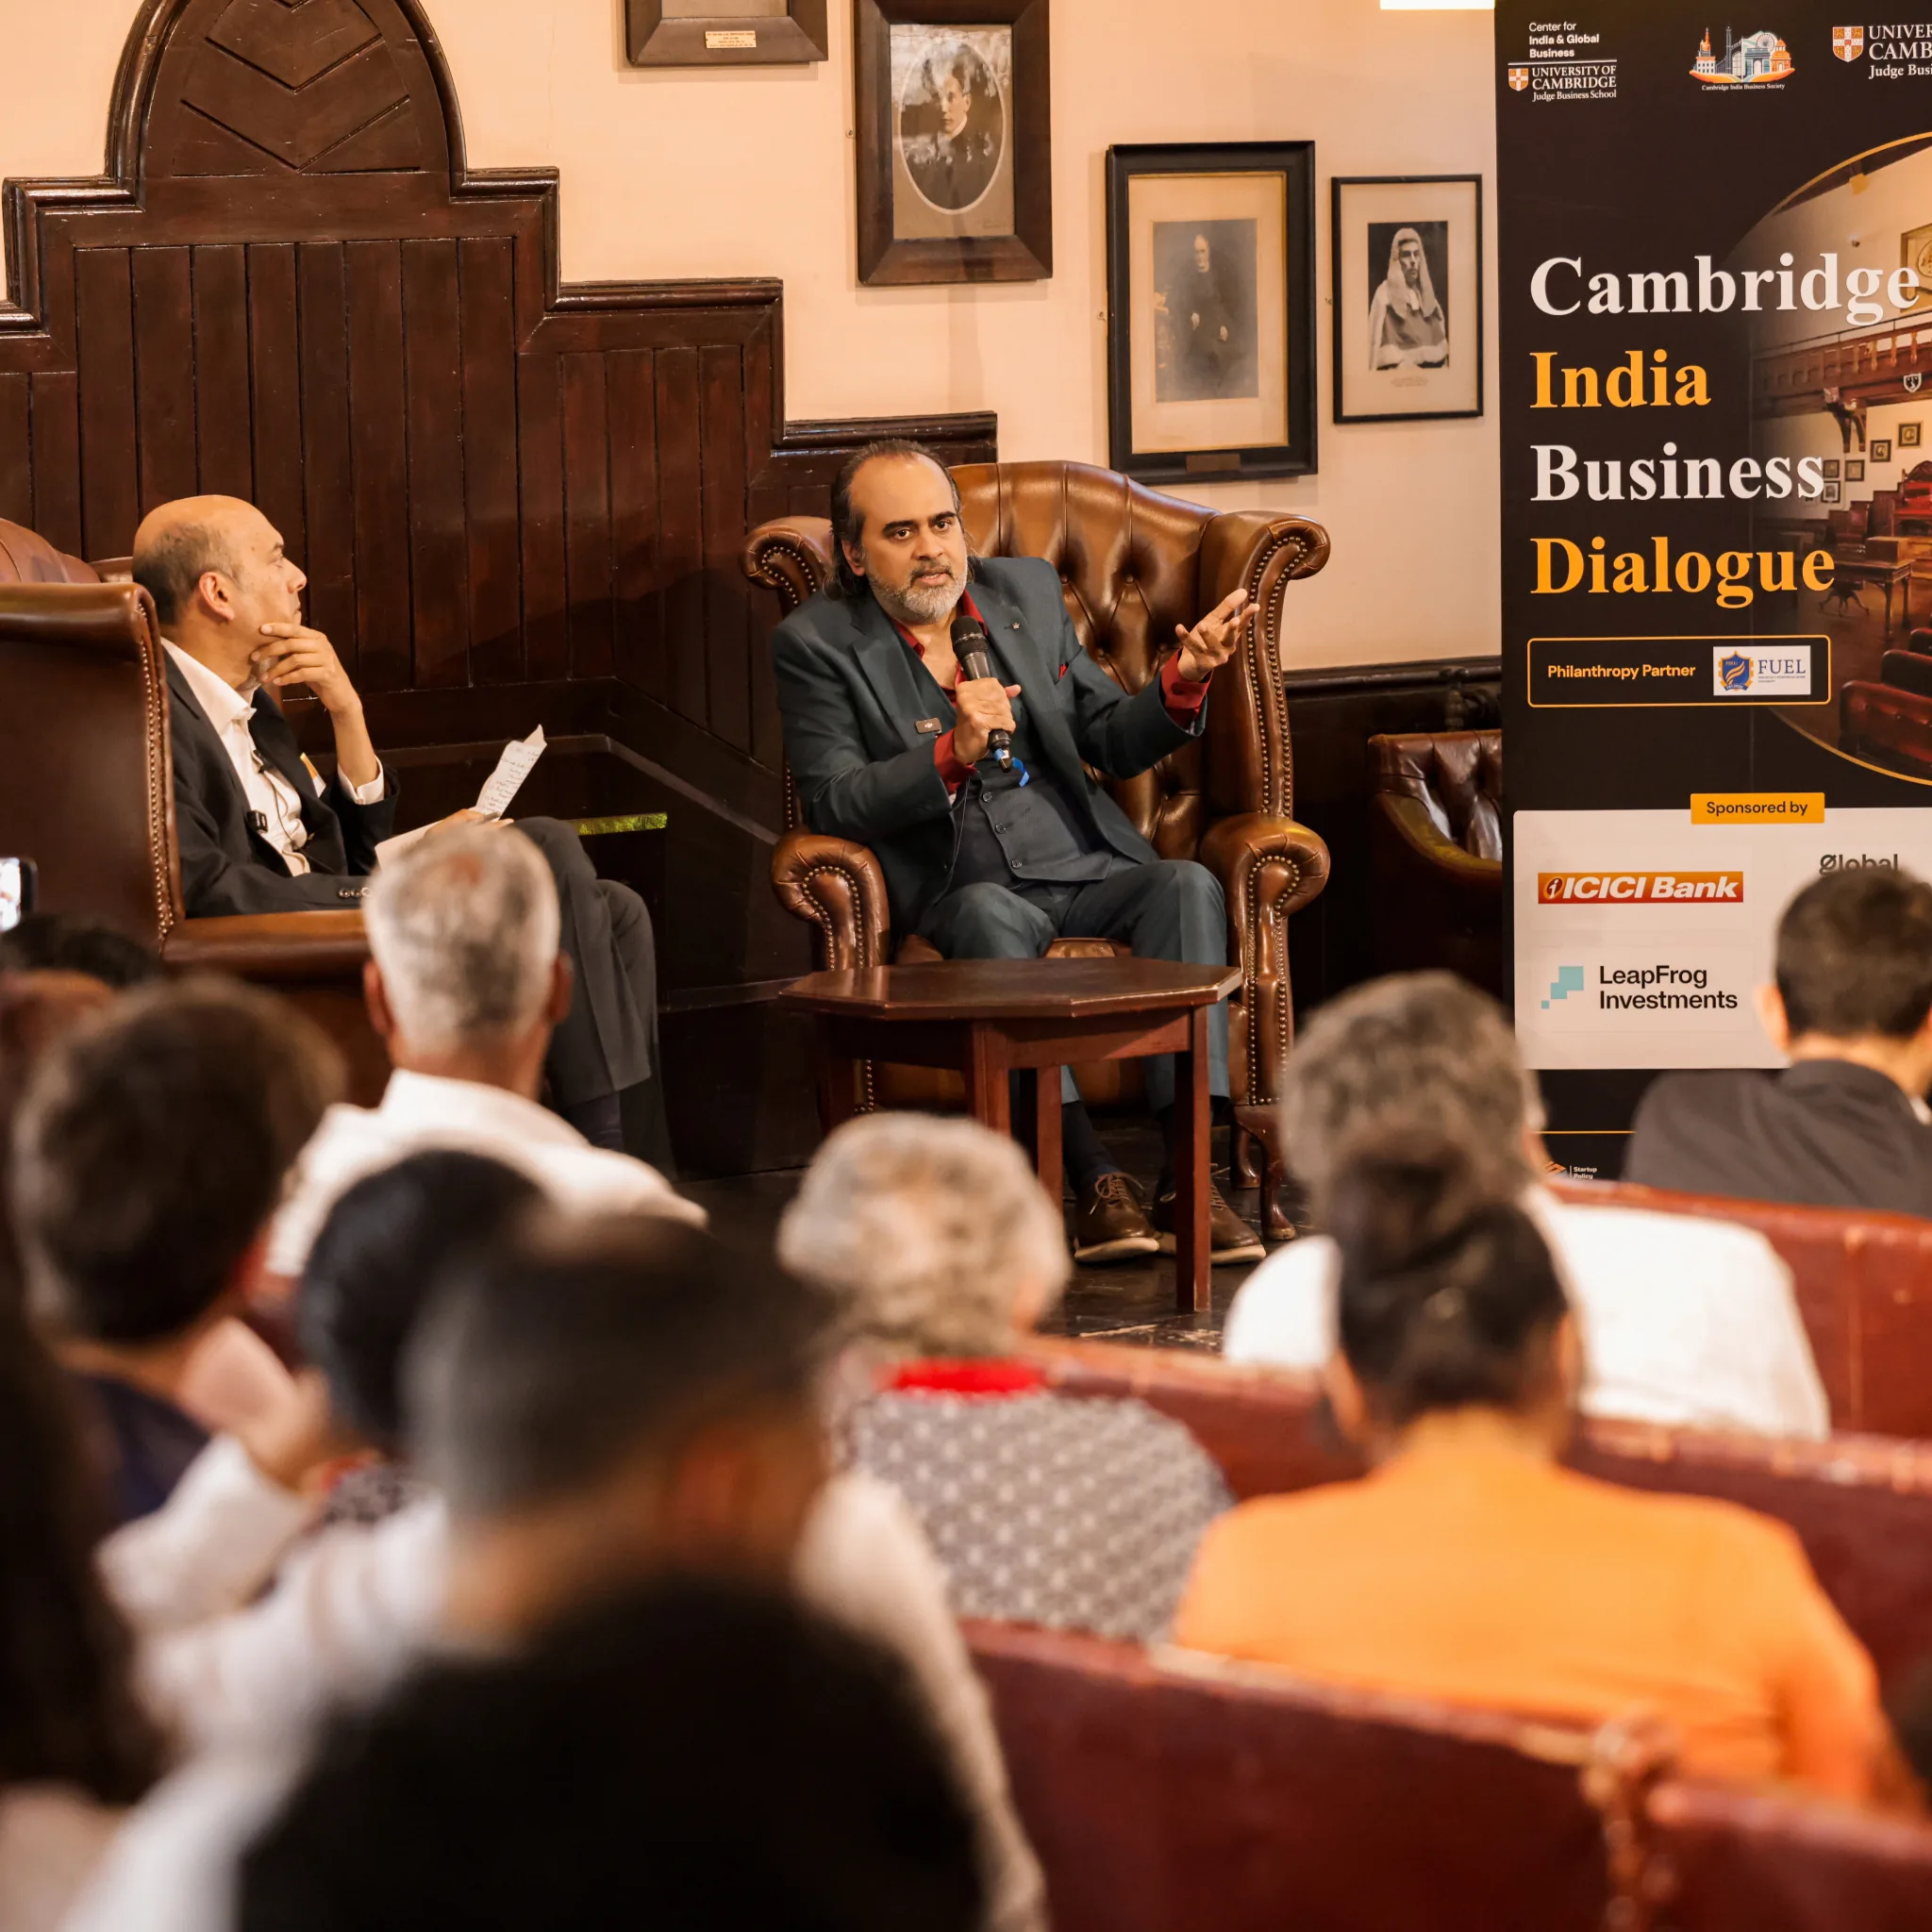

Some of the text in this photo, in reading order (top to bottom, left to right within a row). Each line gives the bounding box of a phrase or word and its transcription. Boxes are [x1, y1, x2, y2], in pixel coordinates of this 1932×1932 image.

[1529, 22, 1576, 32] Center for
[1529, 34, 1600, 45] India & Global
[1529, 48, 1574, 58] Business
[1869, 42, 1932, 60] CAMB
[1532, 65, 1617, 76] UNIVERSITY OF
[1868, 64, 1904, 79] Judge
[1532, 76, 1617, 90] CAMBRIDGE
[1532, 90, 1617, 102] Judge Business School
[1530, 252, 1921, 326] Cambridge
[1529, 348, 1711, 408] India
[1530, 441, 1824, 502] Business
[1530, 536, 1835, 609] Dialogue
[1548, 664, 1696, 680] Philanthropy Partner
[1757, 659, 1807, 675] FUEL
[1707, 801, 1807, 817] Sponsored by
[1562, 876, 1646, 899] ICICI
[1651, 875, 1739, 898] Bank
[1600, 965, 1707, 990] LeapFrog
[1600, 991, 1738, 1009] Investments
